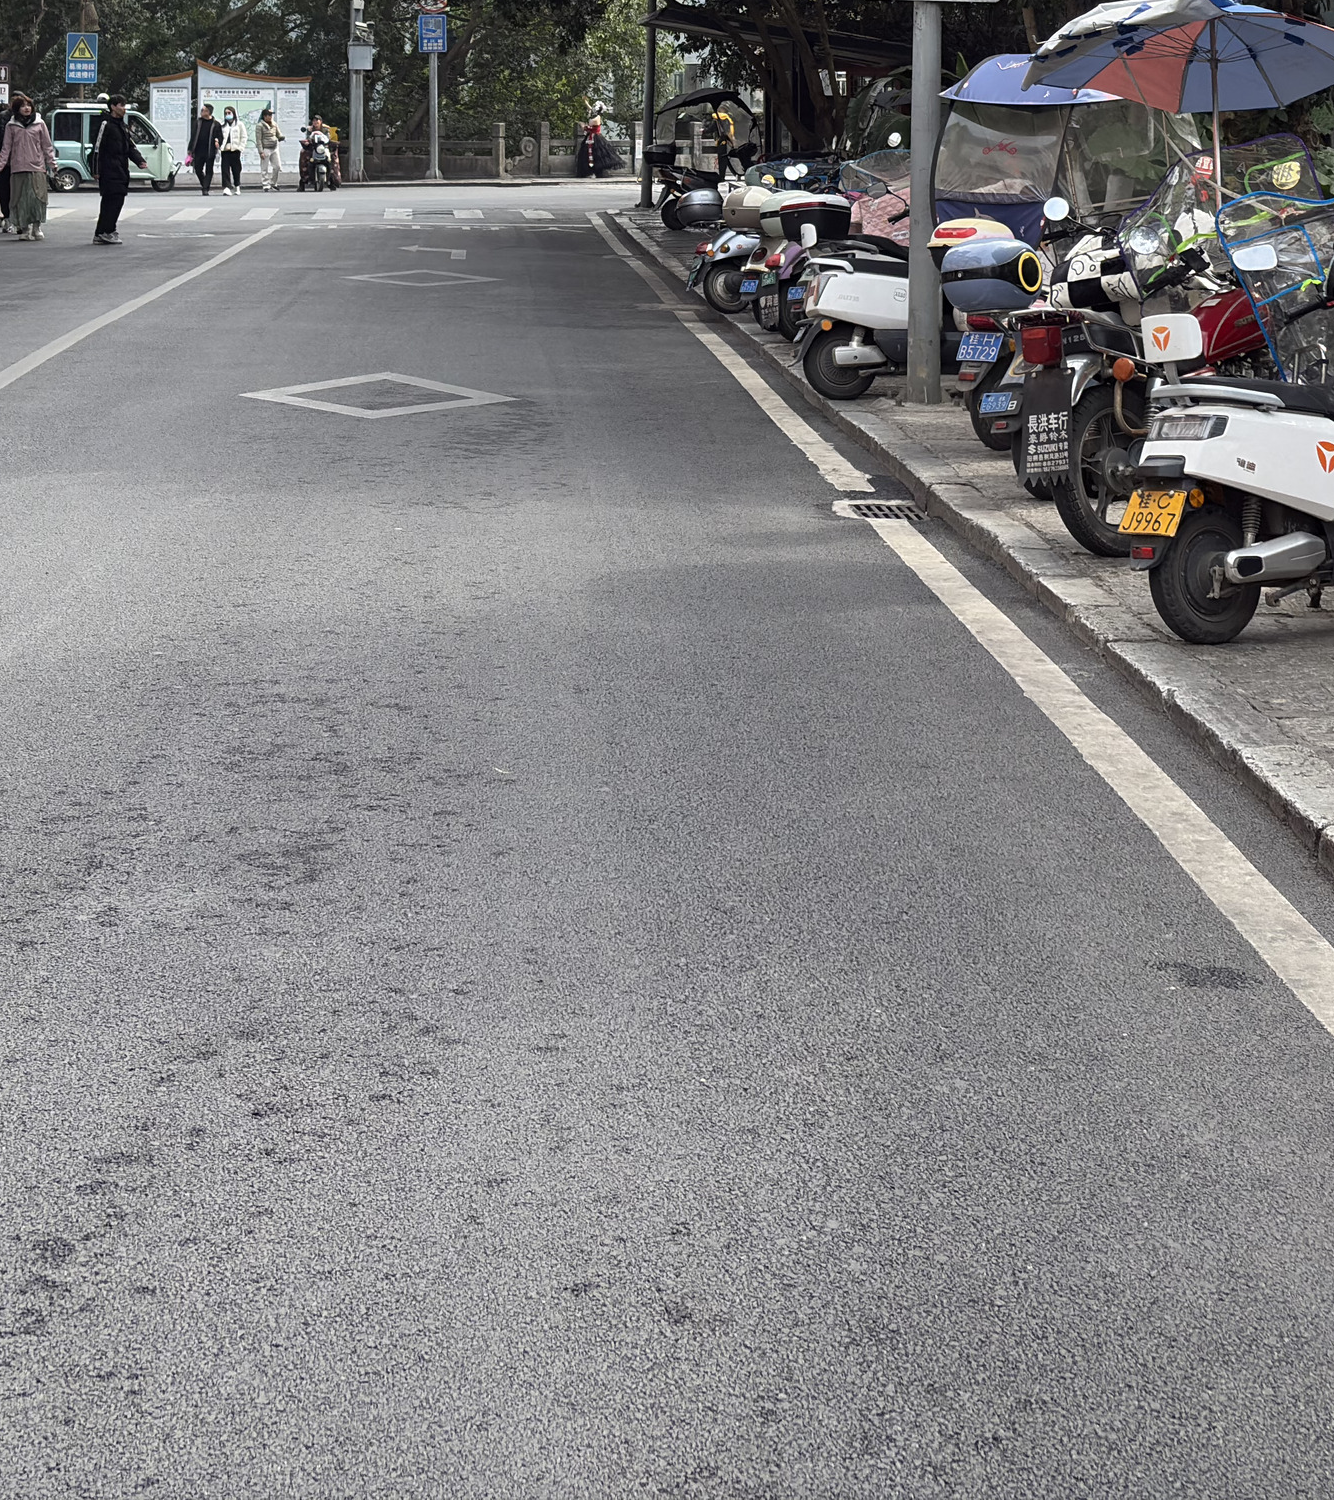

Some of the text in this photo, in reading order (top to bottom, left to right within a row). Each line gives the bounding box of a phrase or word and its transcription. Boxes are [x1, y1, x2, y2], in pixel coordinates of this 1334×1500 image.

[968, 334, 995, 346] 桂·H
[959, 346, 997, 361] B5729
[1027, 411, 1068, 433] 長洪车行
[1138, 492, 1172, 510] 桂·C
[1122, 511, 1176, 533] J9967
